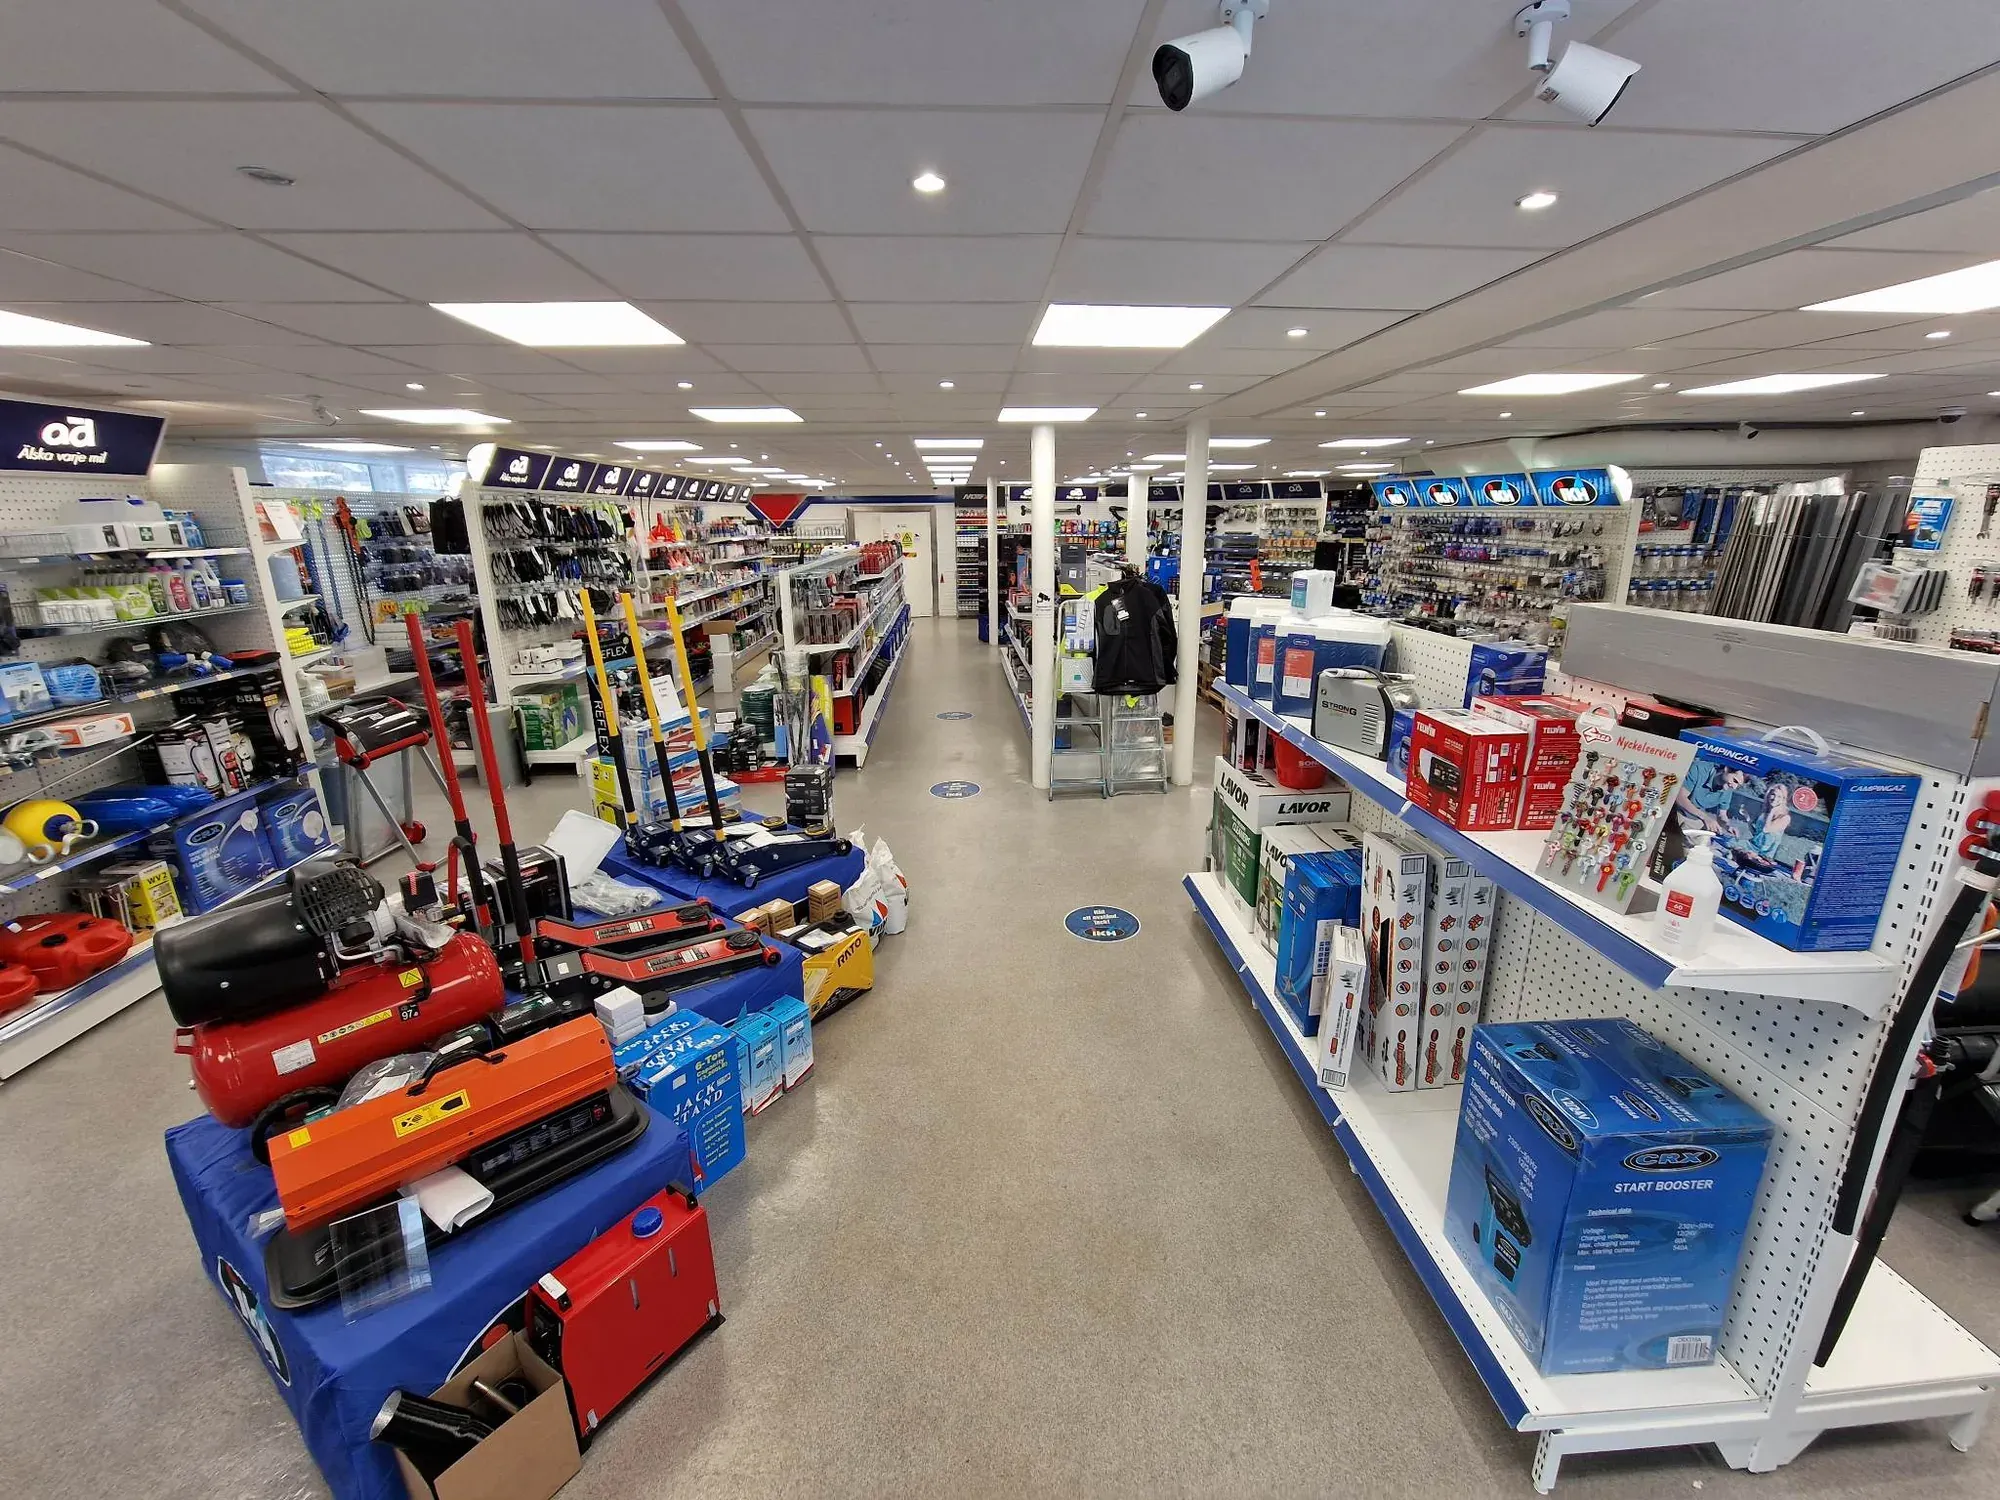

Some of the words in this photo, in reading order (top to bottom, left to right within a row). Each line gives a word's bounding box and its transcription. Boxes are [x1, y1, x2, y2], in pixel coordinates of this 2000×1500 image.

[18, 445, 54, 460] Älska
[56, 452, 86, 465] varje
[89, 451, 107, 464] mil
[602, 646, 628, 659] EFLEX
[1322, 700, 1357, 716] STRONG
[594, 701, 610, 754] REFLEX
[1417, 721, 1436, 737] TELWIN
[1543, 725, 1567, 734] TELWIN
[1617, 736, 1678, 761] Nyckelservice
[1695, 741, 1758, 764] CAMPINGAZ
[1220, 772, 1249, 811] LAVOR
[1533, 781, 1556, 790] TELWIN
[1278, 802, 1331, 814] LAVOR
[190, 827, 220, 844] CRX
[1332, 829, 1363, 848] LAVO
[1265, 840, 1287, 868] LAVO
[1654, 854, 1663, 874] PARTY
[147, 875, 162, 885] WV
[162, 872, 168, 880] 2
[837, 938, 862, 967] RATO
[401, 1010, 412, 1020] 97
[695, 1050, 725, 1070] 6-Ton
[697, 1058, 724, 1077] Capacity
[1473, 1060, 1490, 1080] START
[1490, 1075, 1516, 1109] BOOSTER
[673, 1089, 723, 1125] STAND
[674, 1080, 716, 1116] JACK
[1471, 1077, 1492, 1105] Technical
[1491, 1100, 1503, 1119] data
[1561, 1096, 1590, 1121] 12/24V
[1530, 1100, 1569, 1143] CRX
[1636, 1152, 1704, 1165] CRX
[1614, 1181, 1654, 1193] START
[1655, 1179, 1714, 1191] BOOSTER
[1587, 1208, 1617, 1217] Technical
[1618, 1207, 1632, 1215] data
[1497, 1244, 1517, 1264] STARTER
